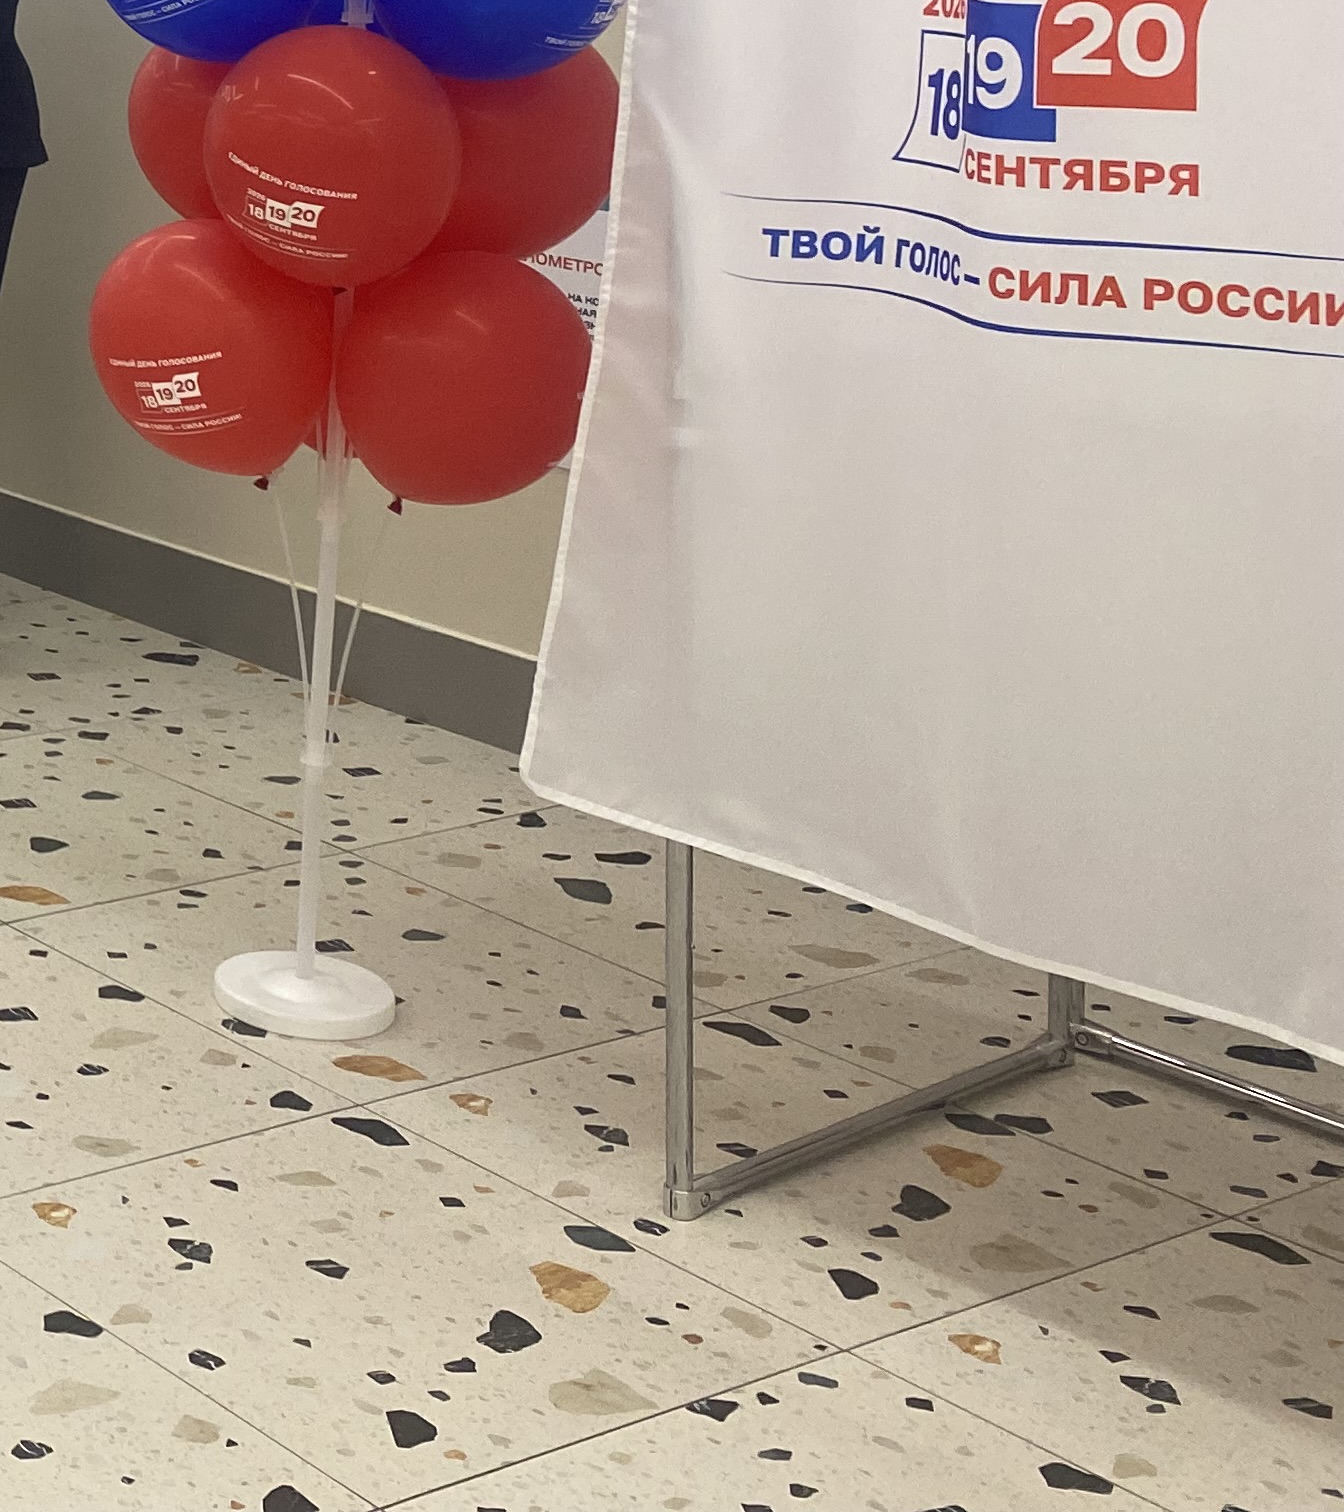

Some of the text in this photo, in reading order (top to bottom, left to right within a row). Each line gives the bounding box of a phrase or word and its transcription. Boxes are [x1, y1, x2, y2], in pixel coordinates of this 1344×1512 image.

[928, 1, 1185, 140] 18 19 20
[259, 171, 283, 186] ДЕНЬ
[284, 180, 358, 200] ГОЛОСОВАНИЯ
[964, 148, 1200, 197] СЕНТЯБРЯ
[249, 204, 316, 222] 18 19 20
[762, 226, 885, 265] ТВОЙ
[895, 238, 960, 285] ГОЛОС
[988, 267, 1127, 309] СИЛА
[137, 360, 157, 368] ДЕНЬ
[158, 351, 222, 367] ГОЛОСОВАНИЯ
[141, 379, 196, 408] 18 19 20
